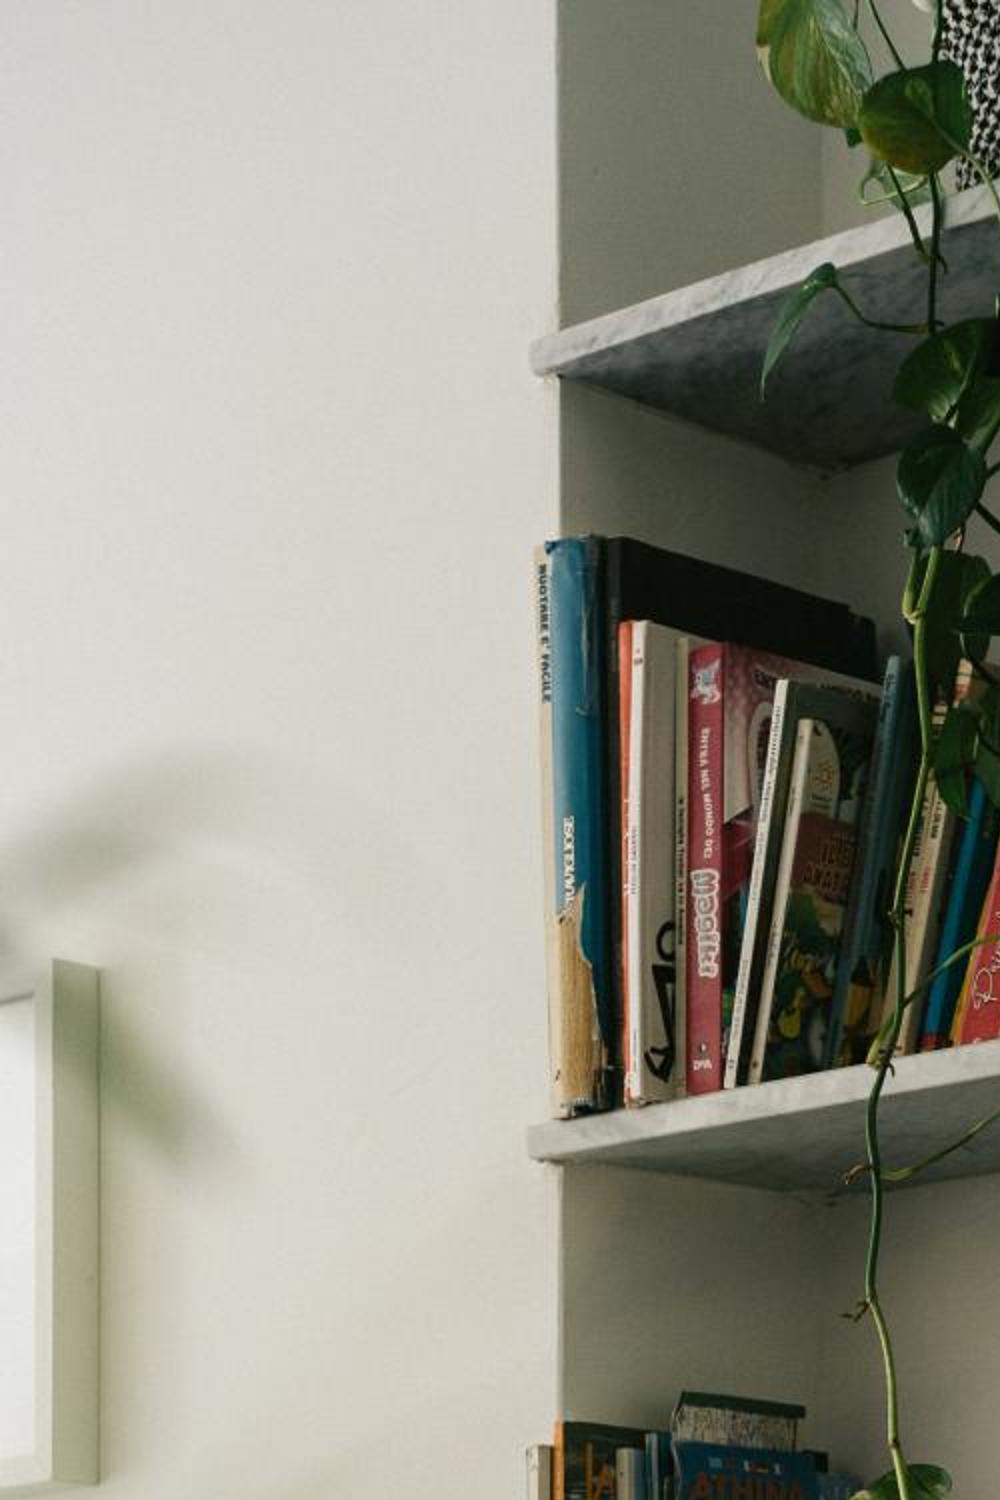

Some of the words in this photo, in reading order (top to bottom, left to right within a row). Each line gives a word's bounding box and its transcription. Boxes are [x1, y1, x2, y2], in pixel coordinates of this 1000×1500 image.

[540, 653, 551, 704] FACILE
[699, 727, 711, 767] ENTRA
[700, 769, 709, 791] NEL
[702, 793, 714, 837] MONDO
